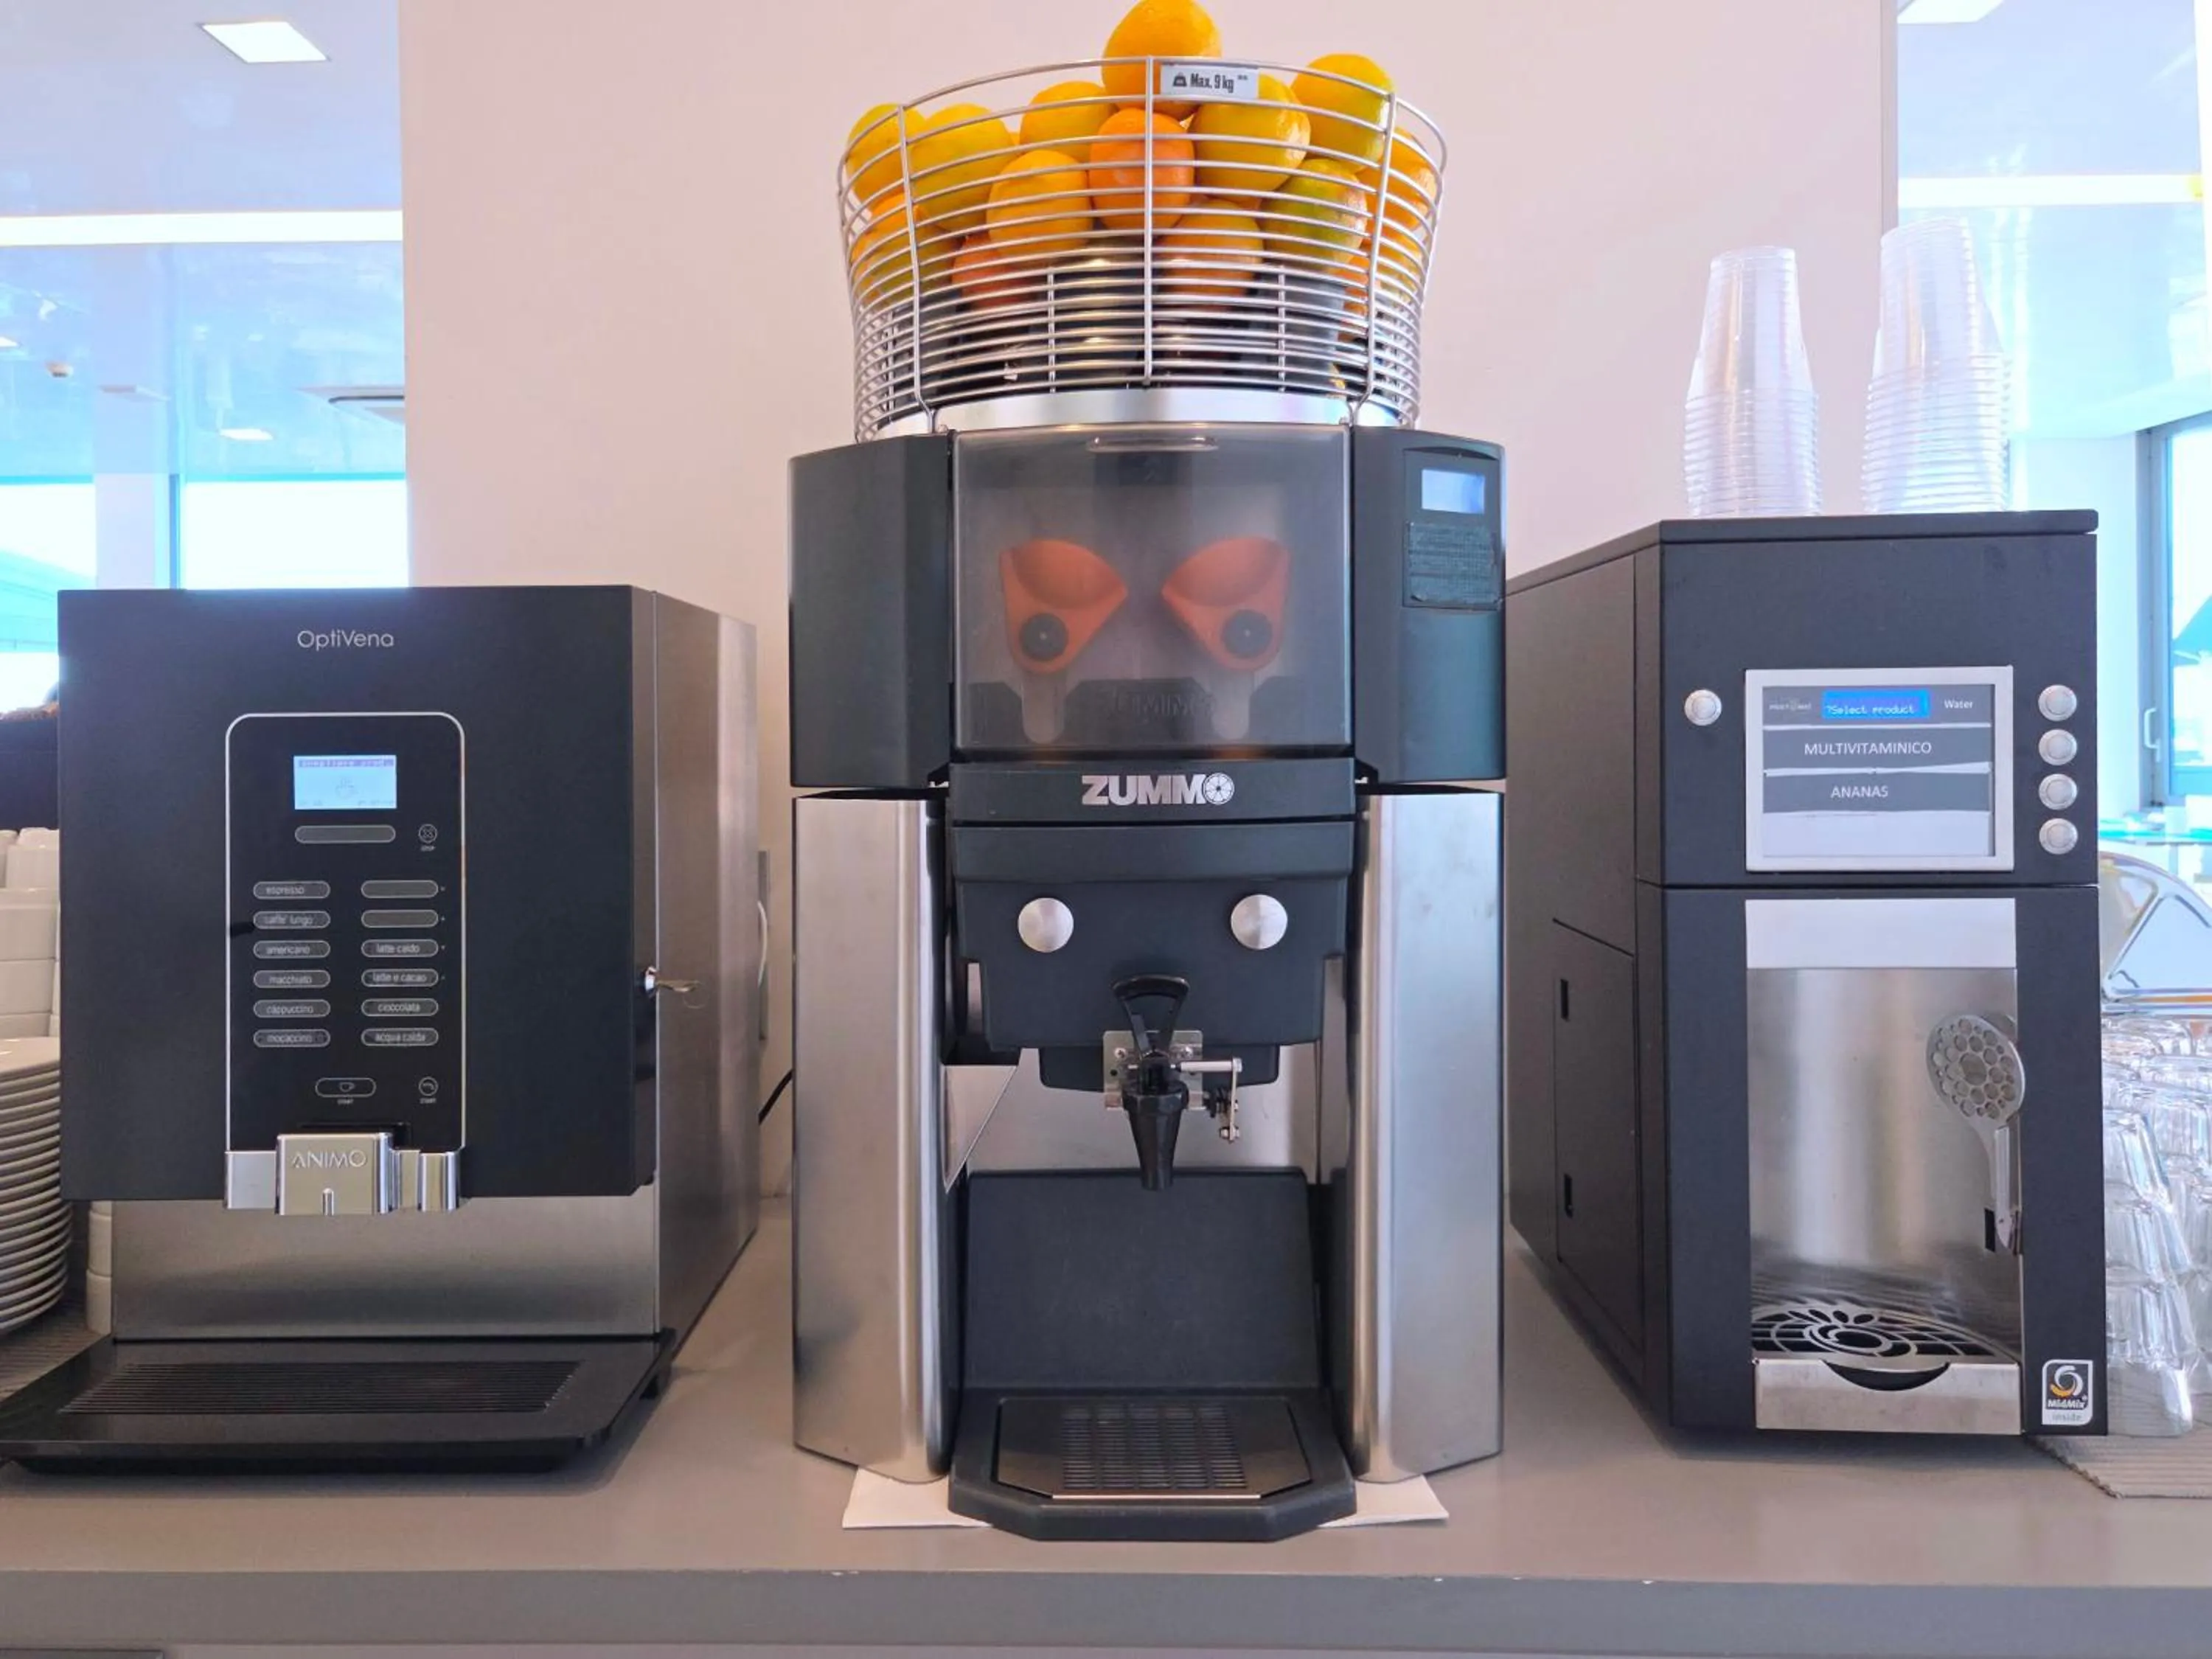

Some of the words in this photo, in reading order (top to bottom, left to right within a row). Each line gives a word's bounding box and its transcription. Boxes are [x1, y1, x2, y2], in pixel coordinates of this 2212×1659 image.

[1190, 73, 1212, 89] Max.
[1214, 74, 1220, 89] 9
[1222, 74, 1234, 94] kg
[297, 629, 394, 652] OptiVena
[1944, 699, 1973, 709] Water
[1804, 741, 1933, 756] MULTIVITAMINICO
[1082, 772, 1235, 806] ZUMMO
[1830, 785, 1889, 799] ANANAS
[293, 1150, 366, 1168] ANIMO
